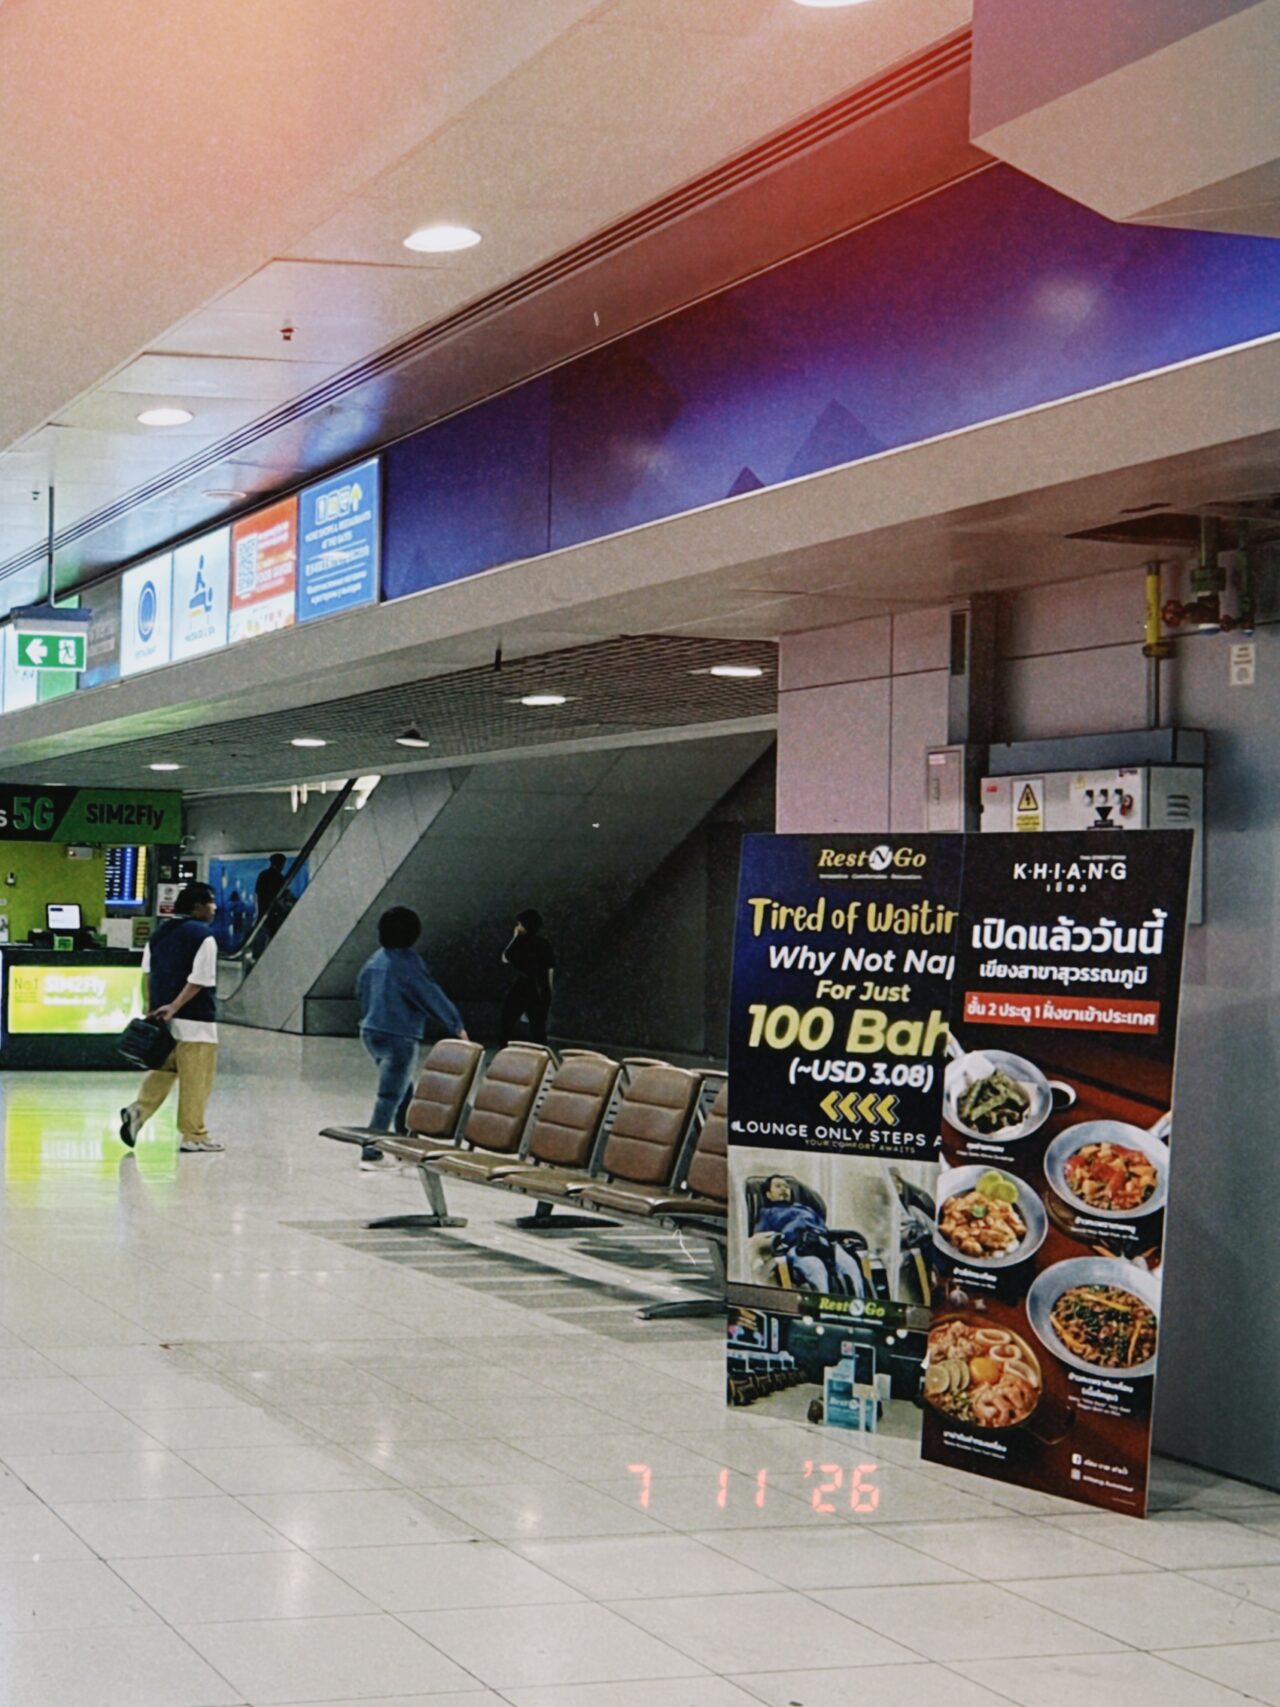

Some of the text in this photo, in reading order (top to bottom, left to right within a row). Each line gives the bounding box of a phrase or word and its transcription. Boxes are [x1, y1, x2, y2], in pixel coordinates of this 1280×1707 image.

[12, 796, 54, 831] 5G
[86, 803, 164, 830] SIM2Fly
[748, 897, 825, 937] Tired
[831, 901, 861, 935] of
[972, 908, 1168, 955] เปิดแล้ววันนี้
[770, 945, 836, 976] Why
[841, 947, 896, 973] Not
[816, 980, 911, 1002] For Just
[988, 1003, 997, 1016] 2
[1034, 1005, 1040, 1018] 1
[748, 1004, 834, 1051] 100
[870, 1062, 934, 1093] 3.08)
[815, 1126, 863, 1142] ONLY
[870, 1131, 926, 1147] STEPS
